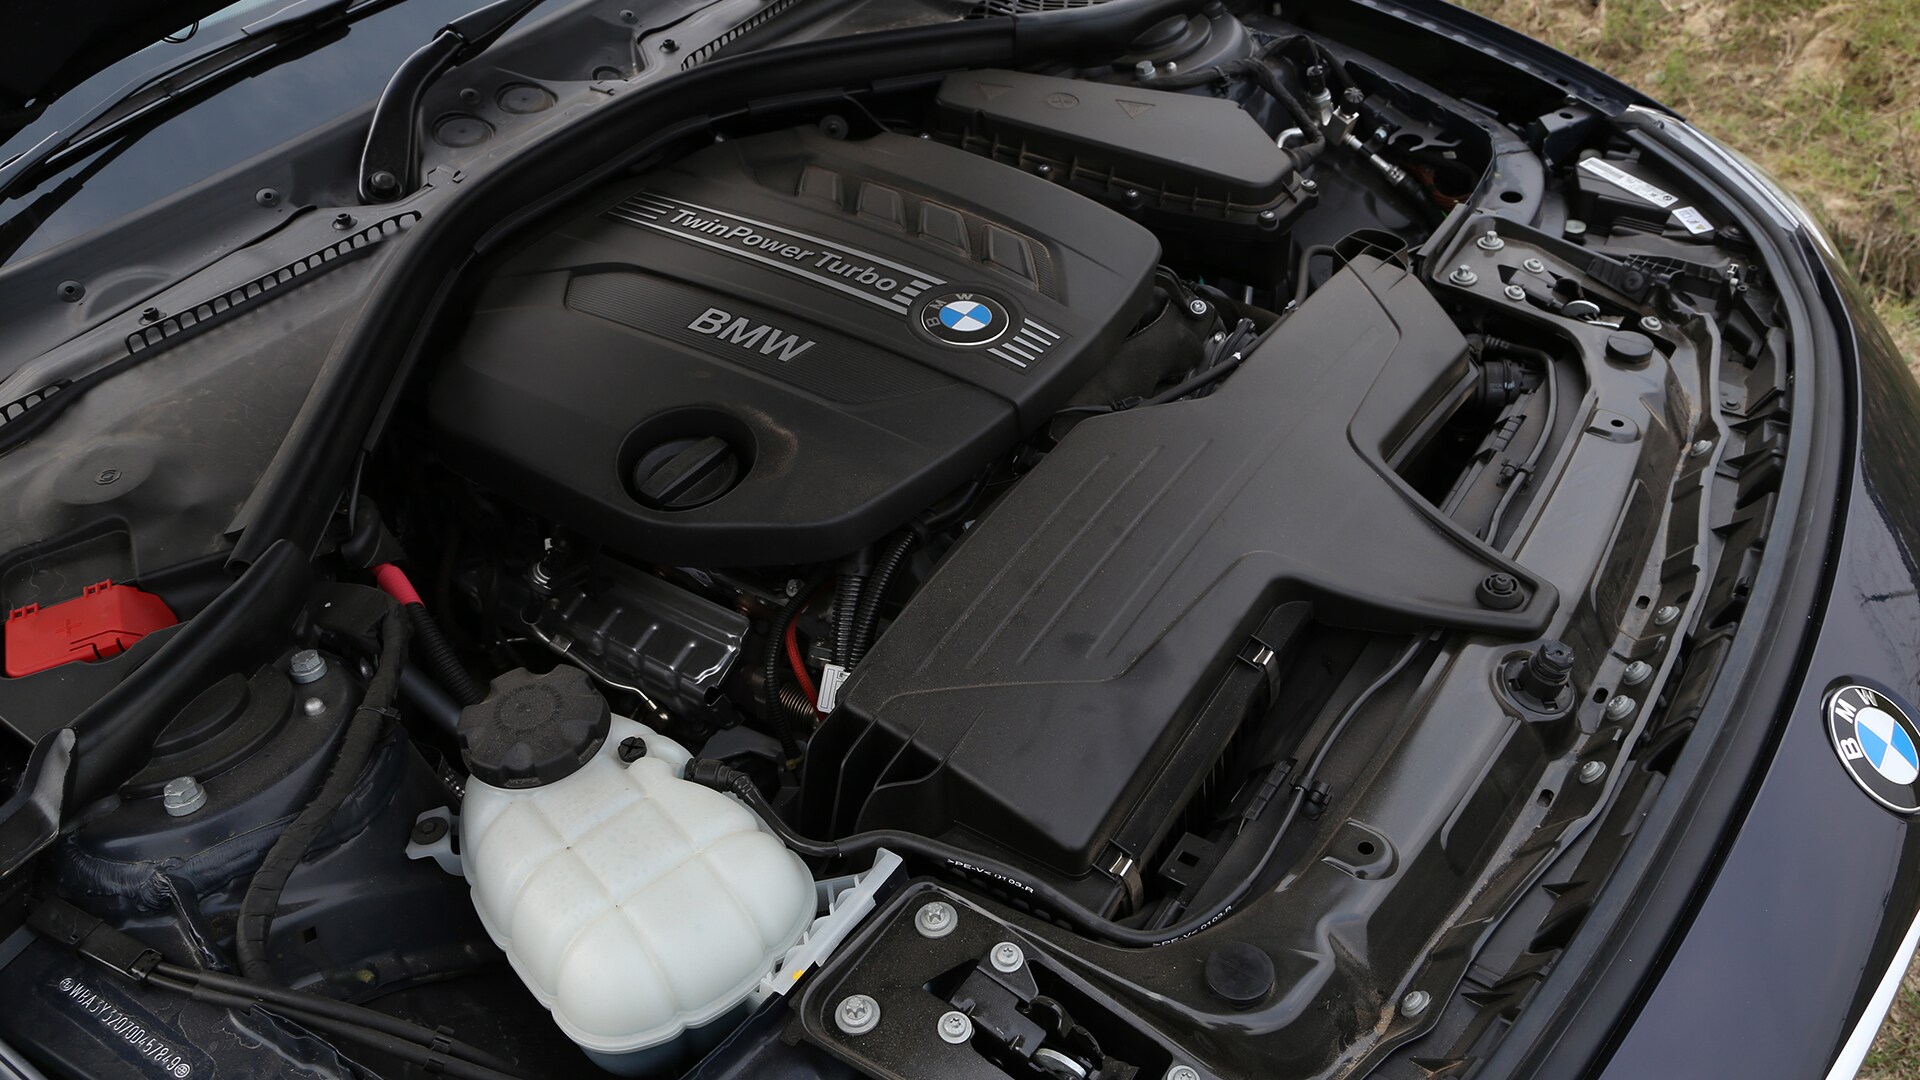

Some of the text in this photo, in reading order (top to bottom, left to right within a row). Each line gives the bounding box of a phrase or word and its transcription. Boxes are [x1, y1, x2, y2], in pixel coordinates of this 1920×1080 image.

[670, 207, 899, 293] TwinPower Turbo
[687, 307, 816, 363] BMW
[924, 293, 974, 330] BMW
[1835, 688, 1879, 760] BMW
